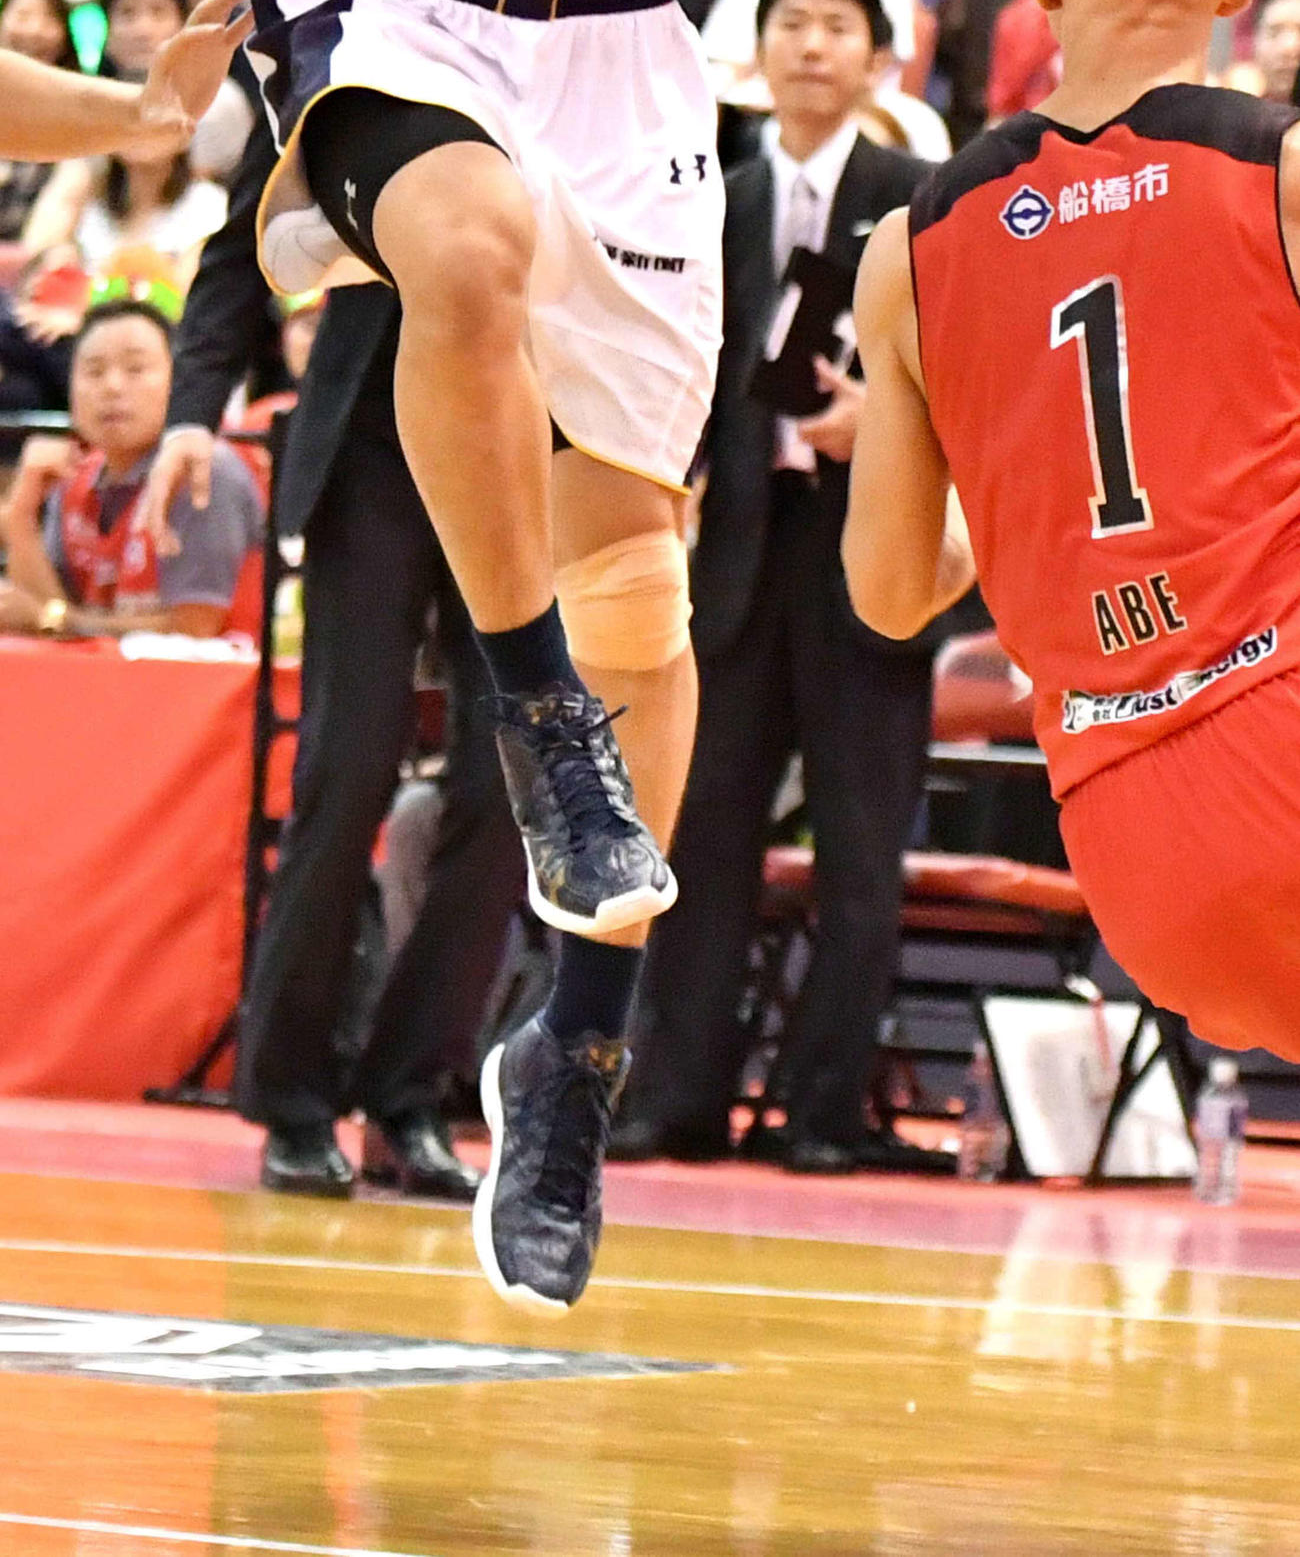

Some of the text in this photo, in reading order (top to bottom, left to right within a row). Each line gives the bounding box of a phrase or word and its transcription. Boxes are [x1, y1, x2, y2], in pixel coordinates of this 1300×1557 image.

[1057, 162, 1170, 224] 船橋市
[1050, 273, 1155, 540] 1
[1091, 569, 1188, 656] ABE
